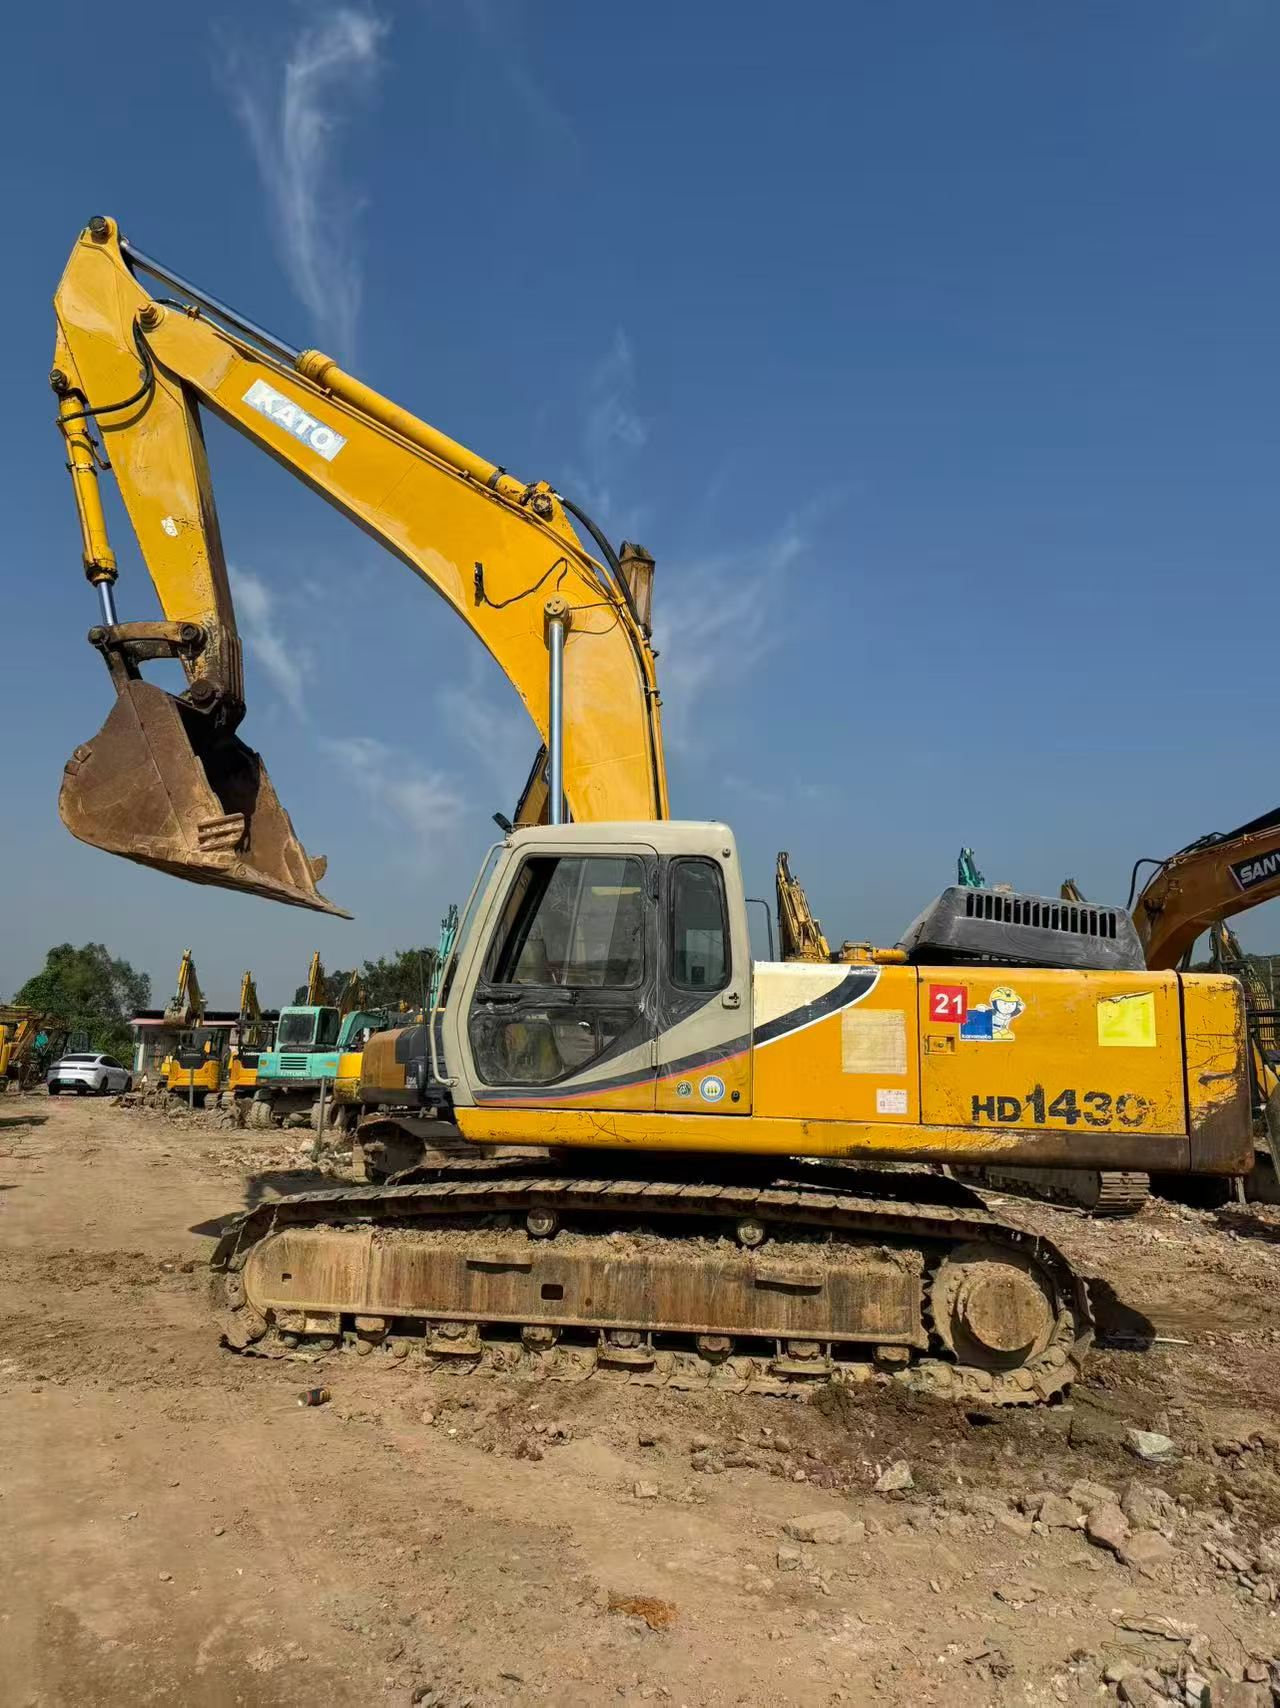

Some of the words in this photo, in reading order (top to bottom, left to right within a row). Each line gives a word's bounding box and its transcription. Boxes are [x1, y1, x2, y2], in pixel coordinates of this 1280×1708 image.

[252, 389, 335, 450] KATO
[935, 993, 962, 1015] 21
[972, 1084, 1147, 1127] HD1430
